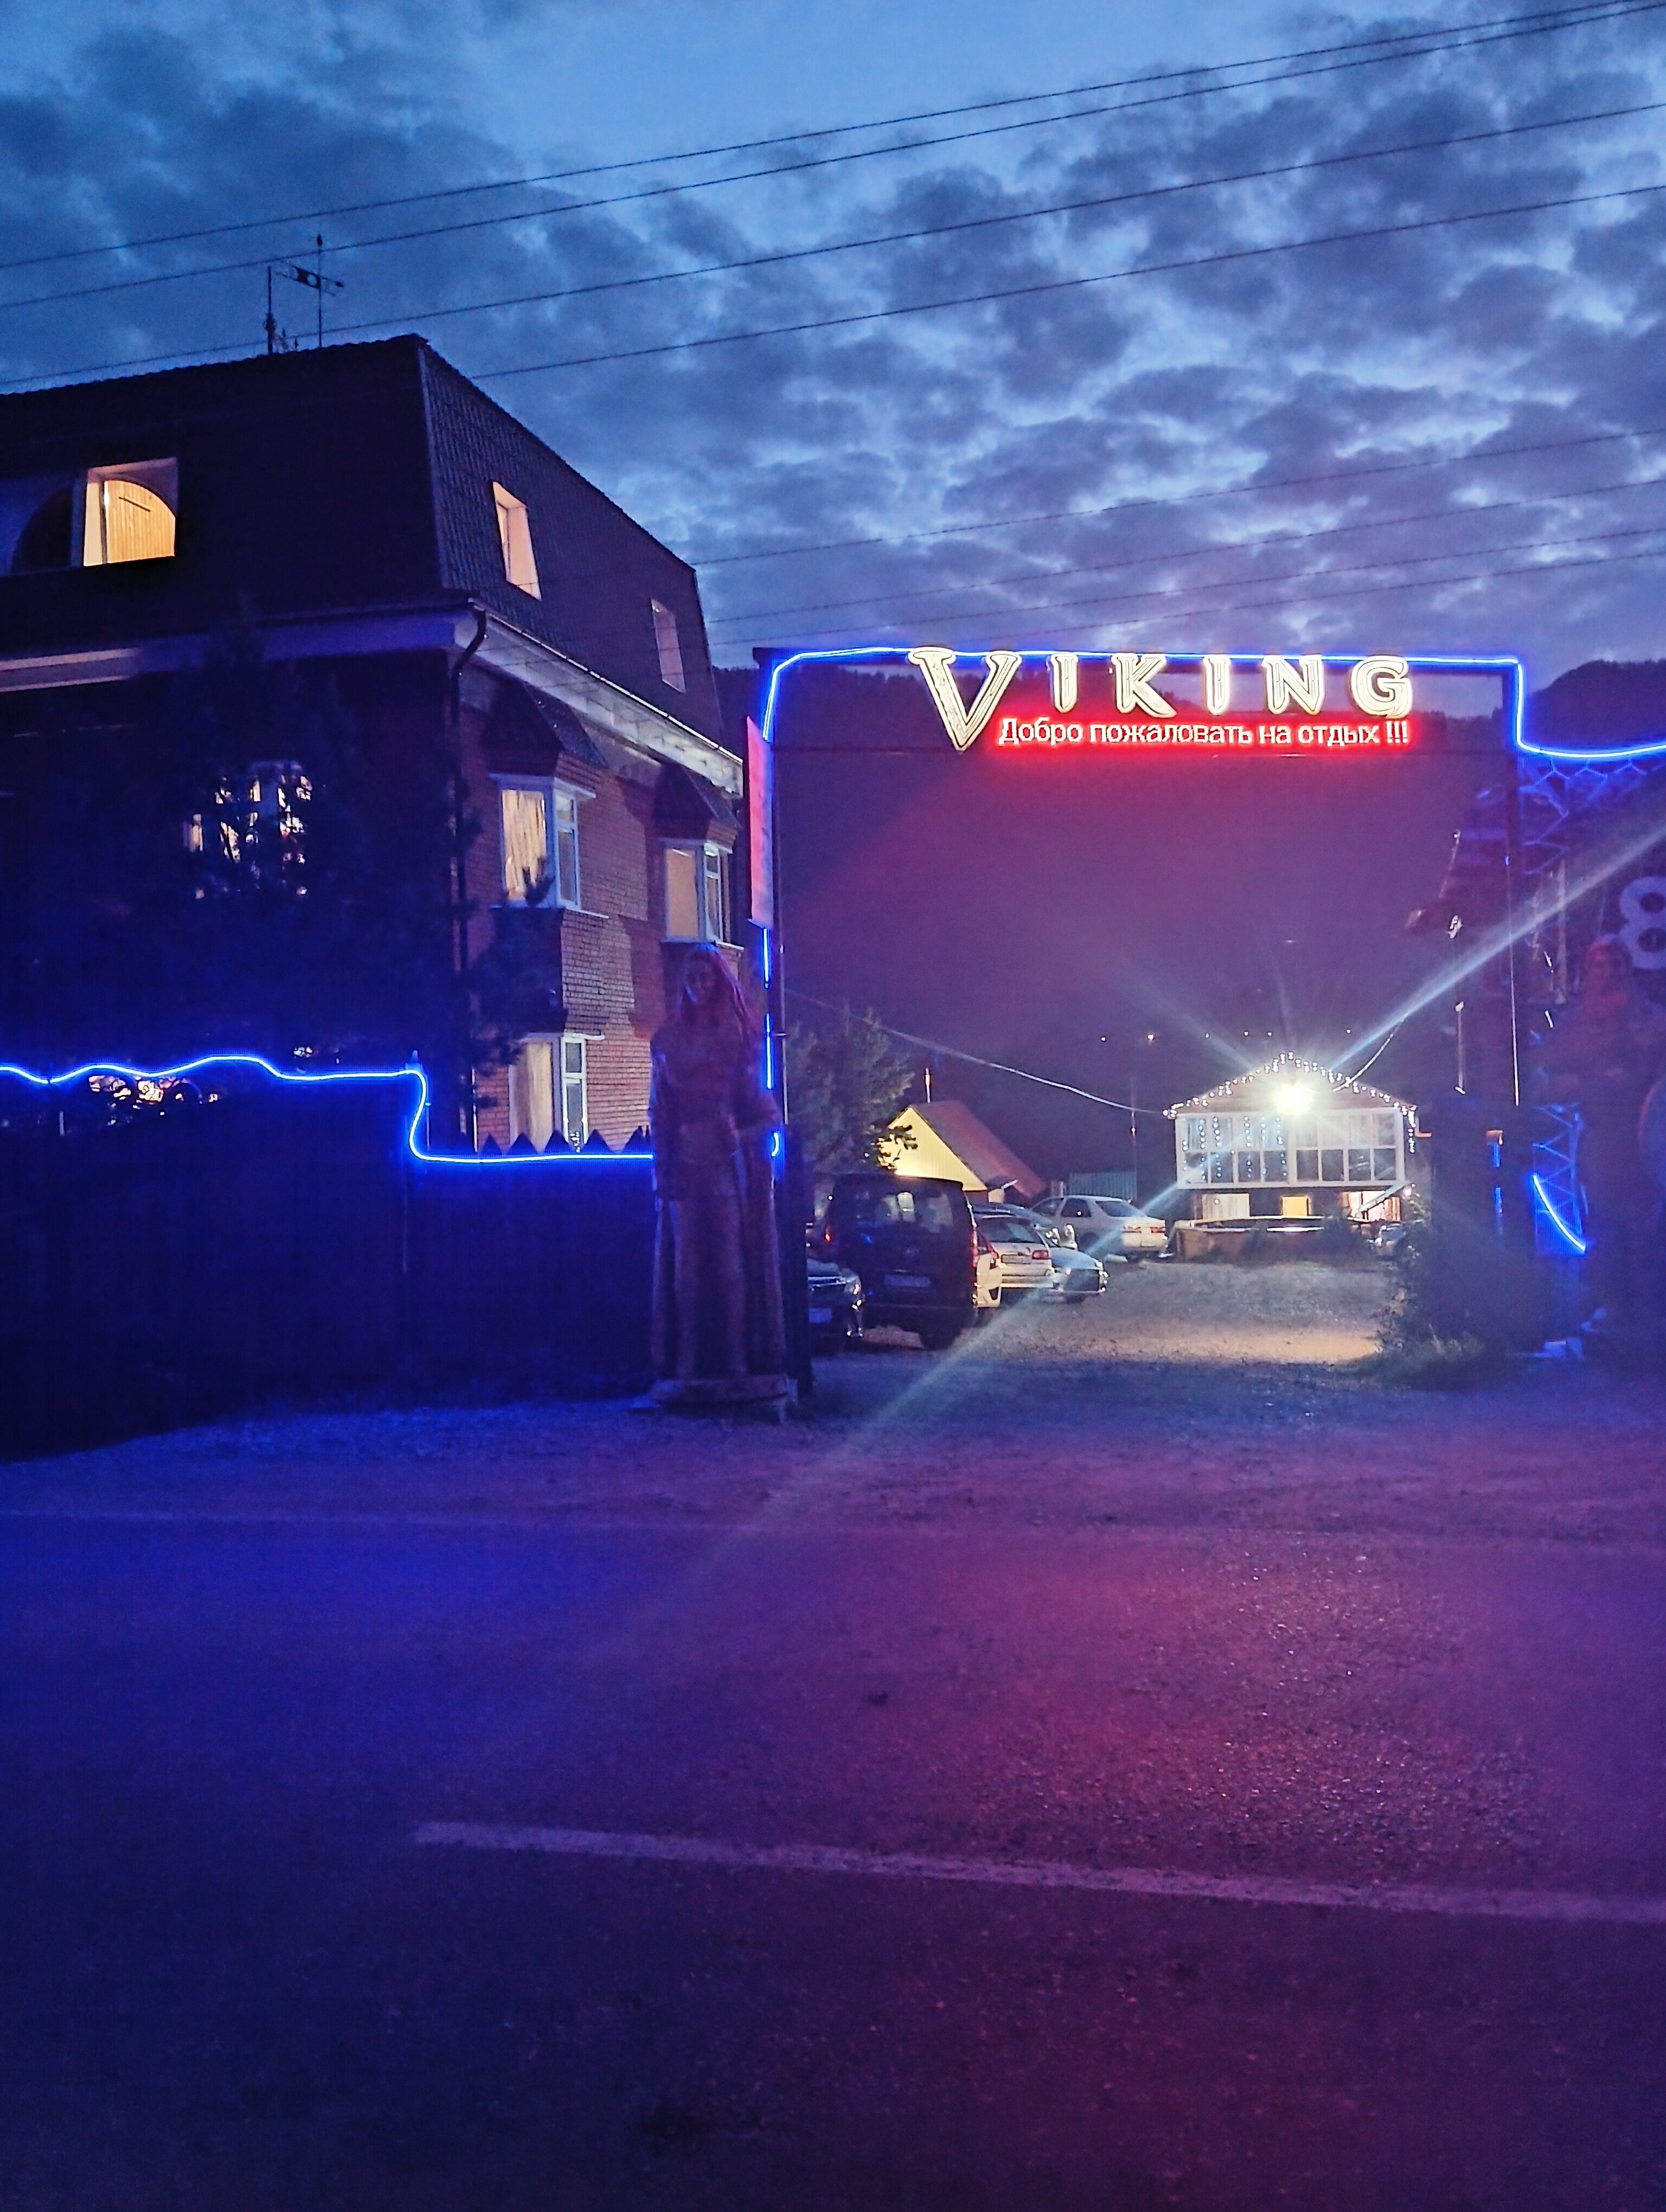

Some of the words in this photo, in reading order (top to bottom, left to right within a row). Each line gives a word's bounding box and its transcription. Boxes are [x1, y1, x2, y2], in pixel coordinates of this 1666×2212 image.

[907, 646, 1413, 751] VIKING
[998, 717, 1083, 746] Добро
[1089, 723, 1253, 744] пожаловать
[1258, 725, 1291, 744] на
[1297, 725, 1380, 747] отдых
[1385, 719, 1408, 744] !!!
